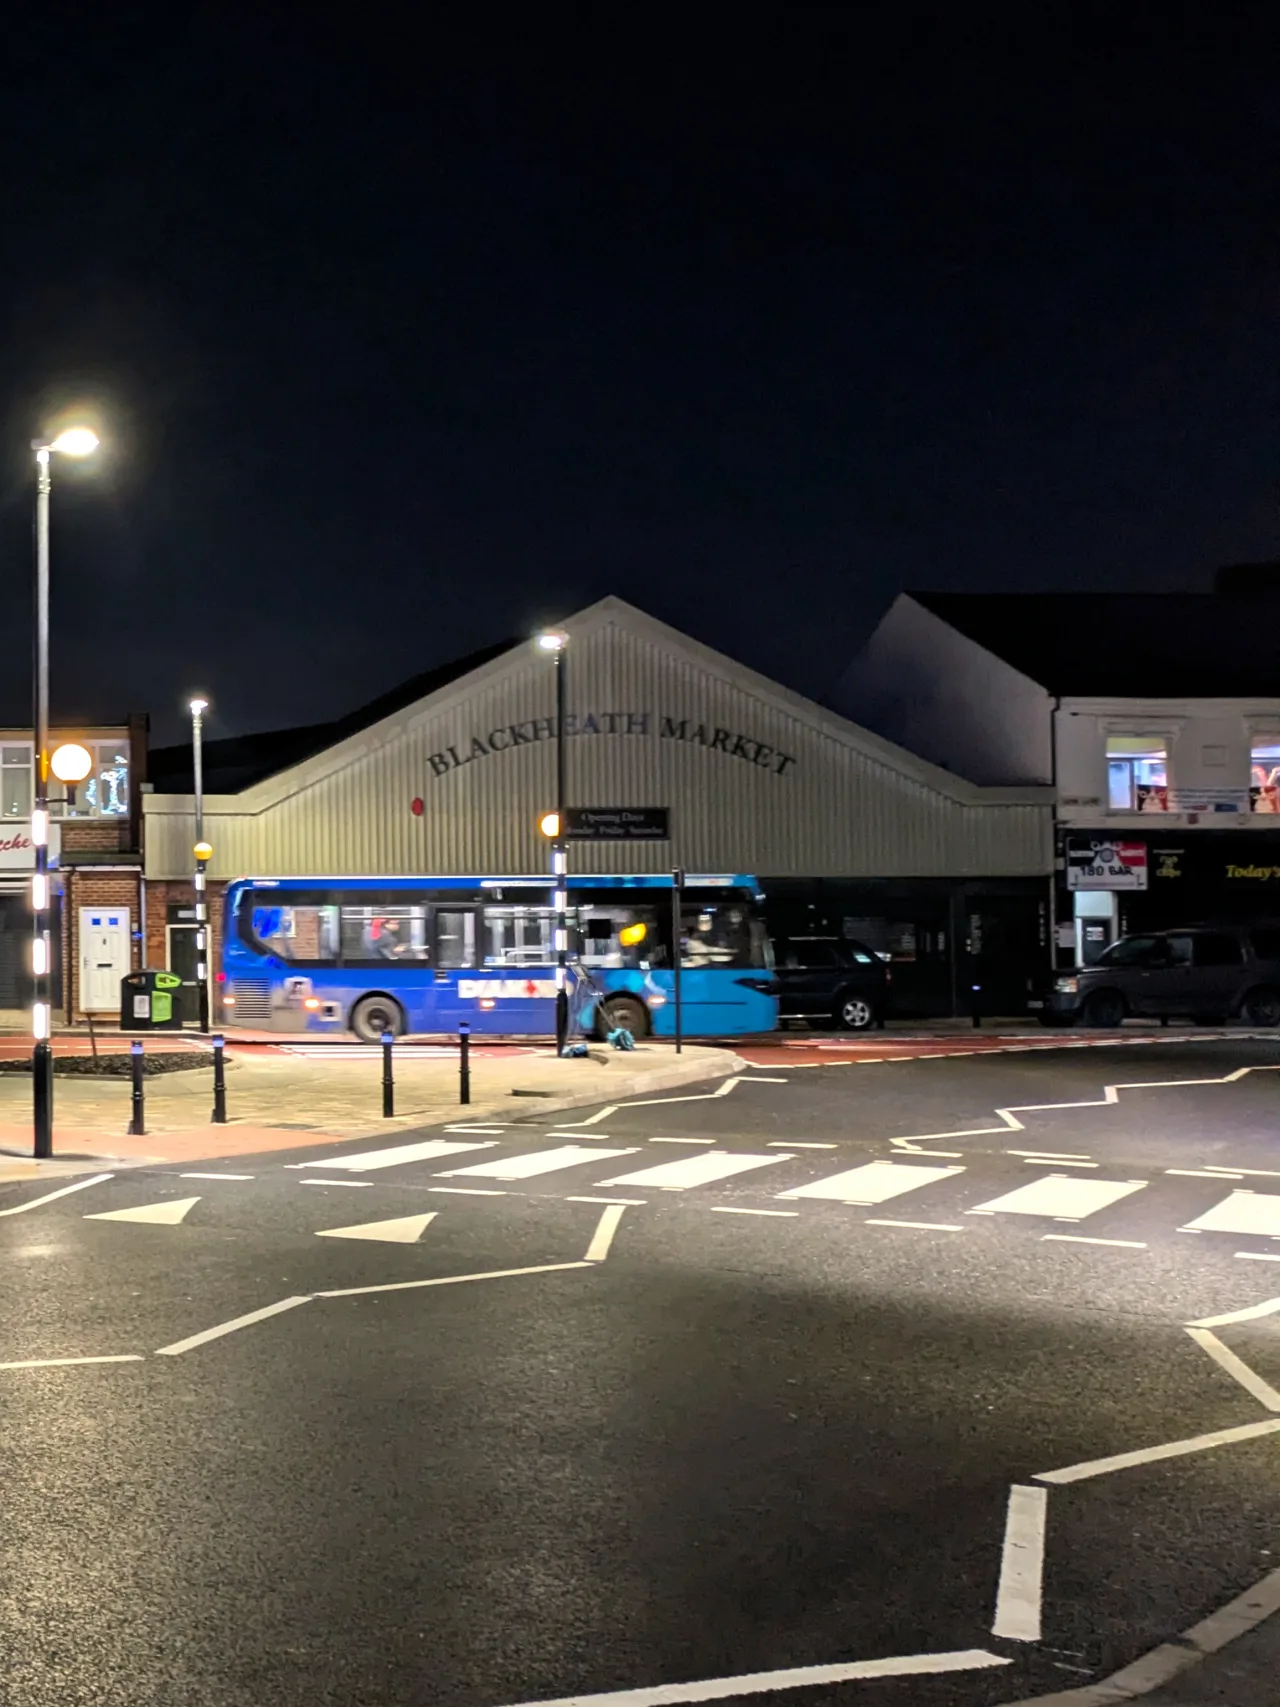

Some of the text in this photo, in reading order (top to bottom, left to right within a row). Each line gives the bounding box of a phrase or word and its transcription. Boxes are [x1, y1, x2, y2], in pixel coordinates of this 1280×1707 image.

[427, 713, 797, 777] BLACKHEATH MARKET
[1080, 865, 1134, 876] 180 BAR
